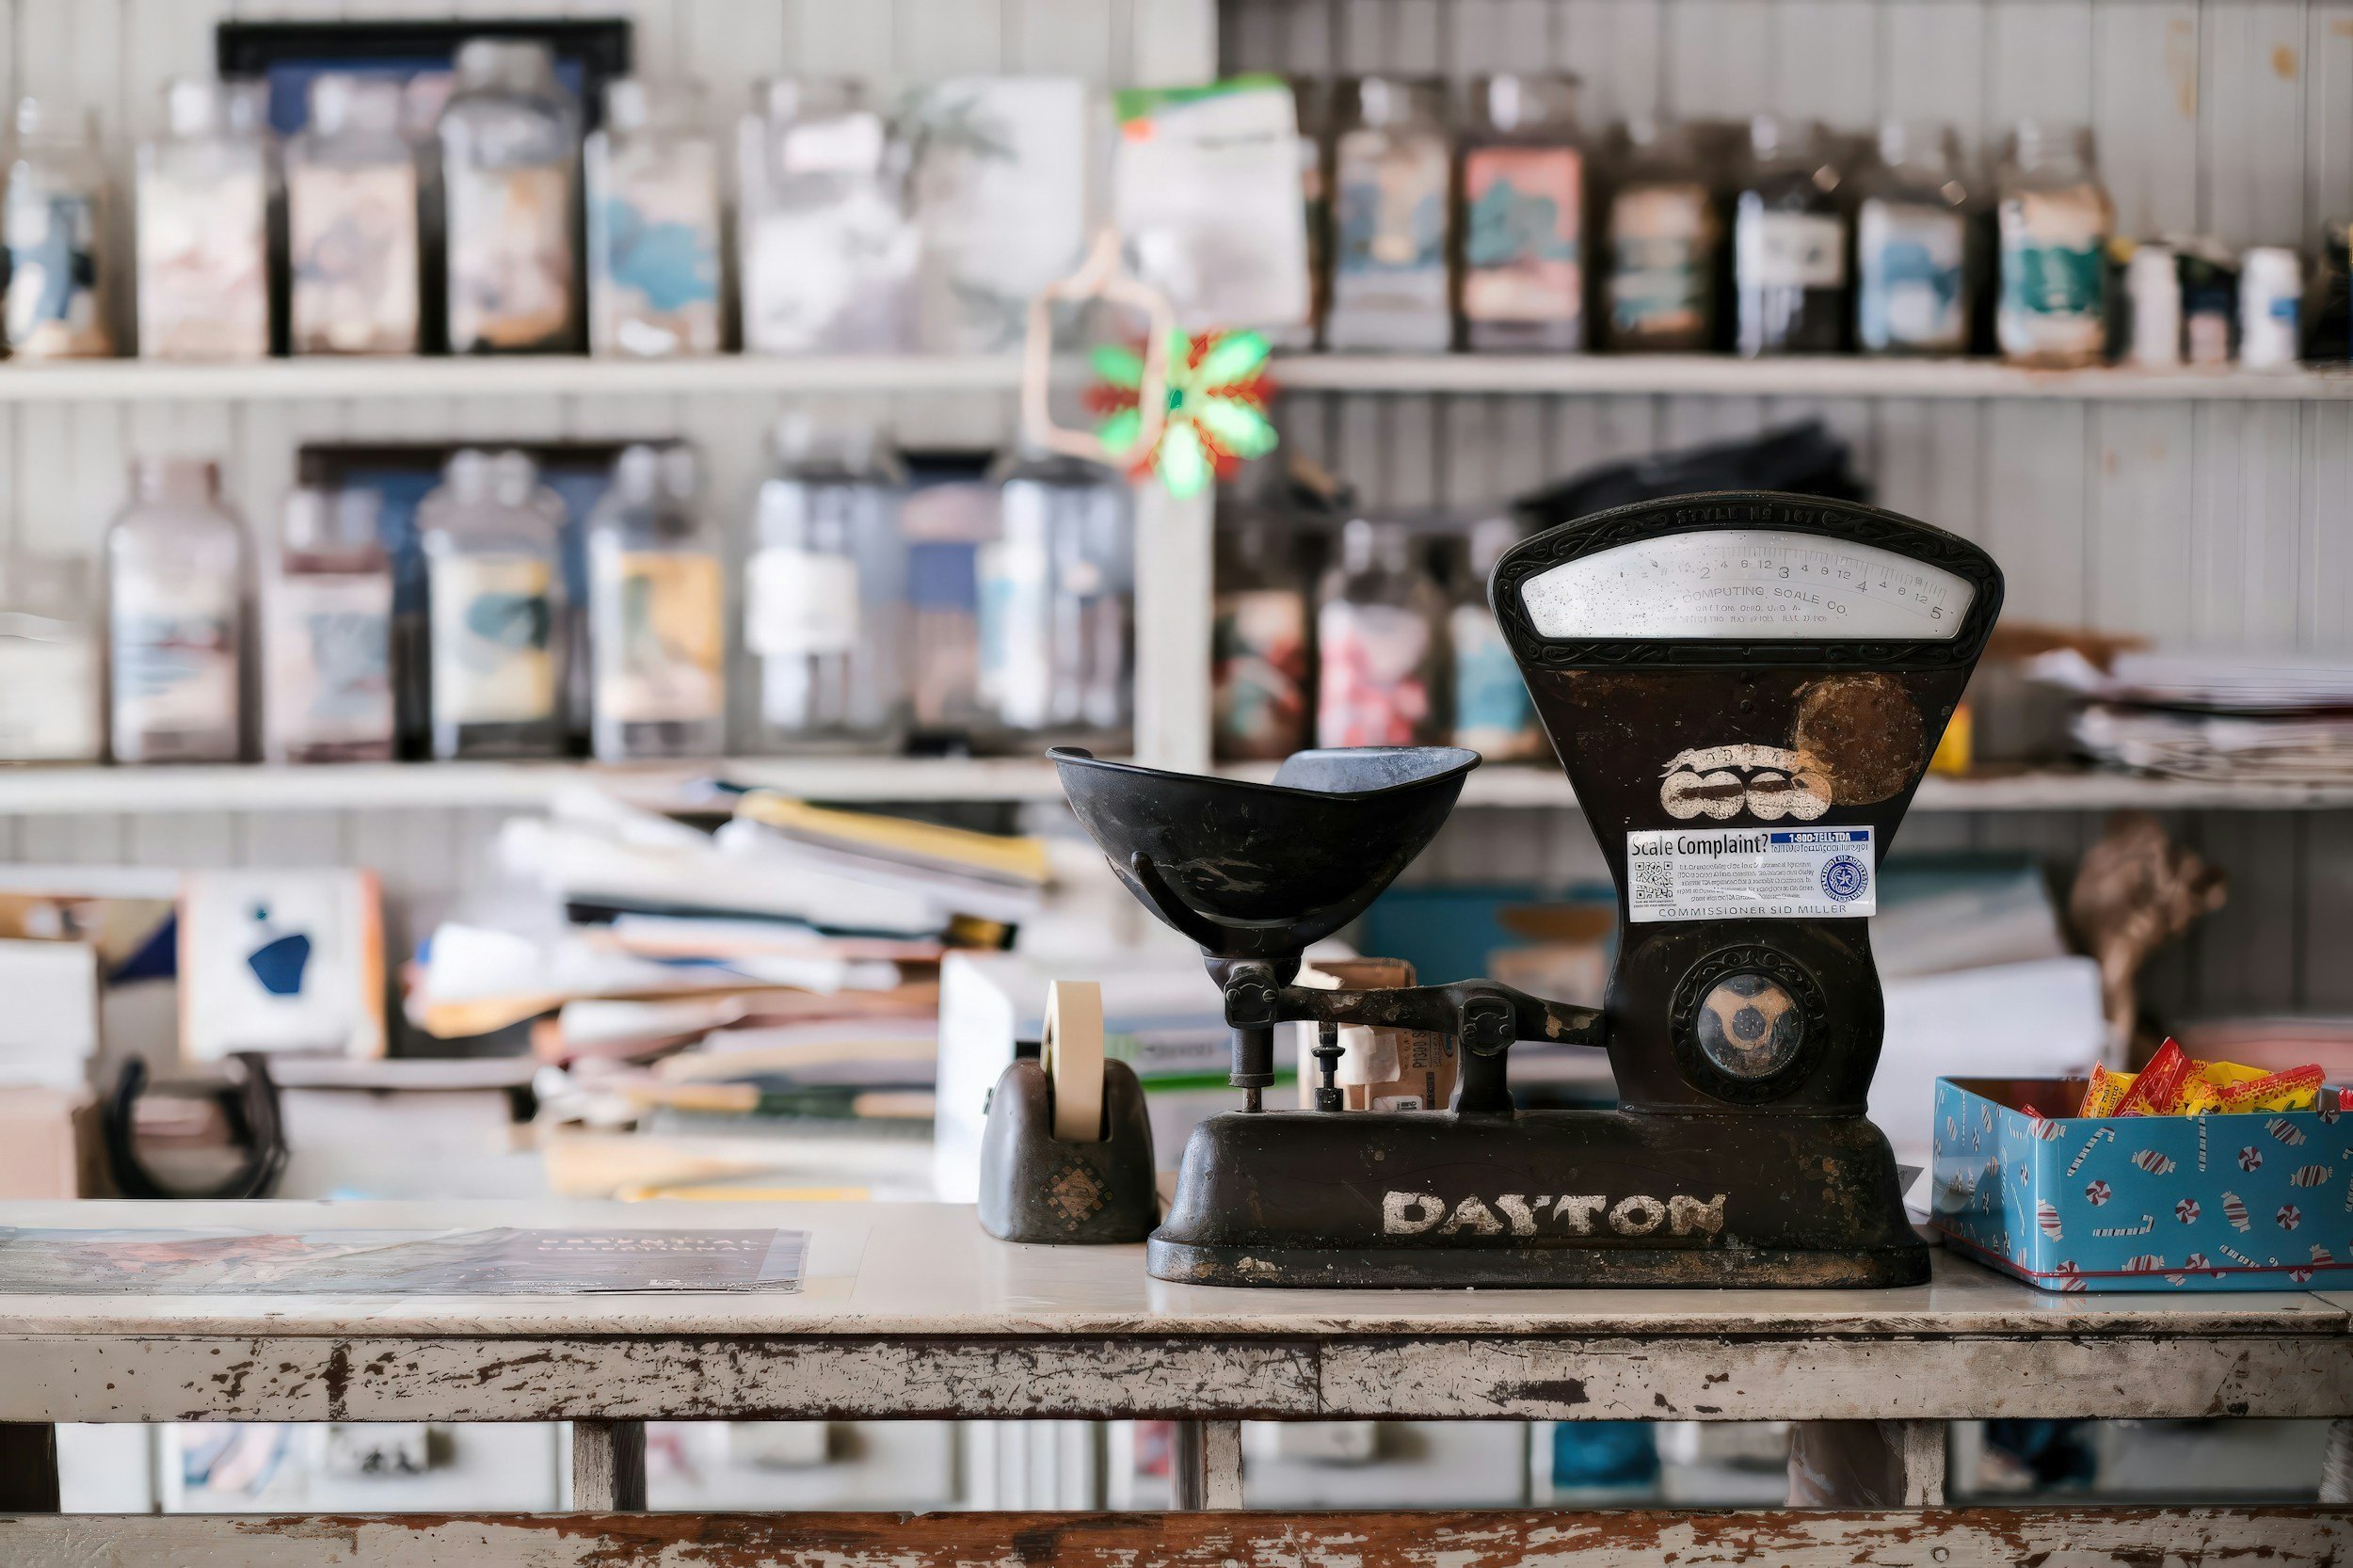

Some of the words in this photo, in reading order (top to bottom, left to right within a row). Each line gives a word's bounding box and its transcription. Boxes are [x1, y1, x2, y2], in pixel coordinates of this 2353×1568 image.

[1699, 567, 1710, 579] 2
[1758, 560, 1772, 569] 12
[1778, 567, 1789, 579] 3
[1836, 570, 1851, 580] 12
[1855, 581, 1867, 593] 4
[1914, 593, 1929, 605] 12
[1930, 606, 1944, 620] 5
[1631, 836, 1673, 856] Scale
[1677, 834, 1769, 859] Complaint?
[1658, 906, 1766, 917] COMMISSIONER
[1770, 905, 1792, 915] SID
[1798, 904, 1847, 914] MILLER
[1382, 1191, 1727, 1237] DAYTON
